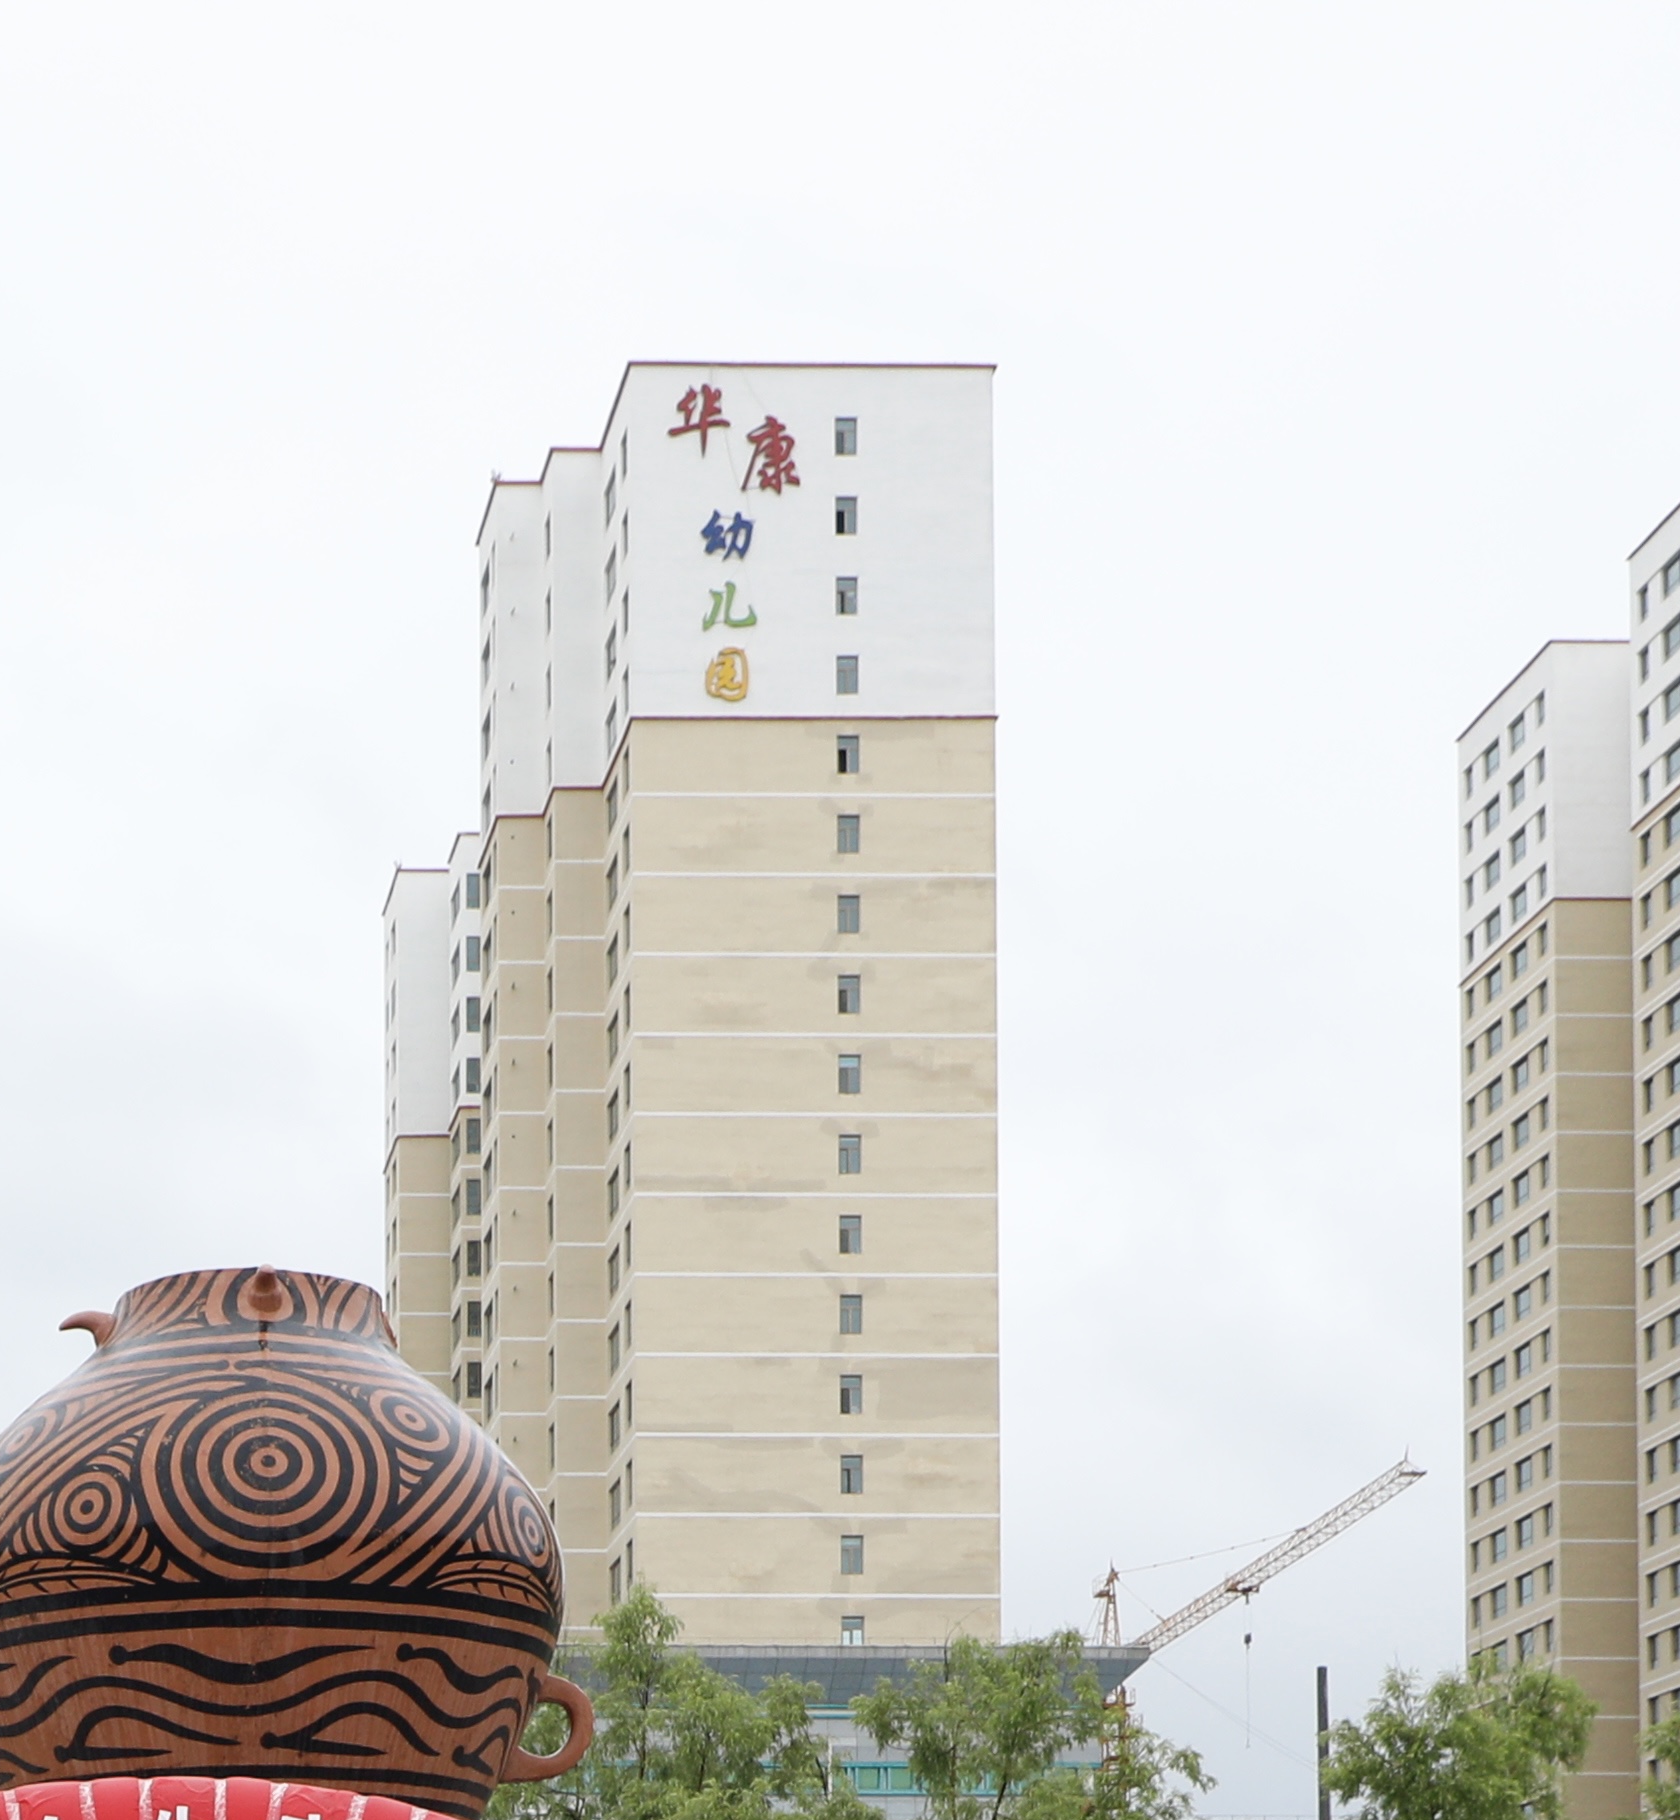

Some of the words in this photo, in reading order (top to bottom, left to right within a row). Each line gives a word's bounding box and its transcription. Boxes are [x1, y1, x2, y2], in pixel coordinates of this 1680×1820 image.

[668, 382, 800, 702] 华康幼儿园
